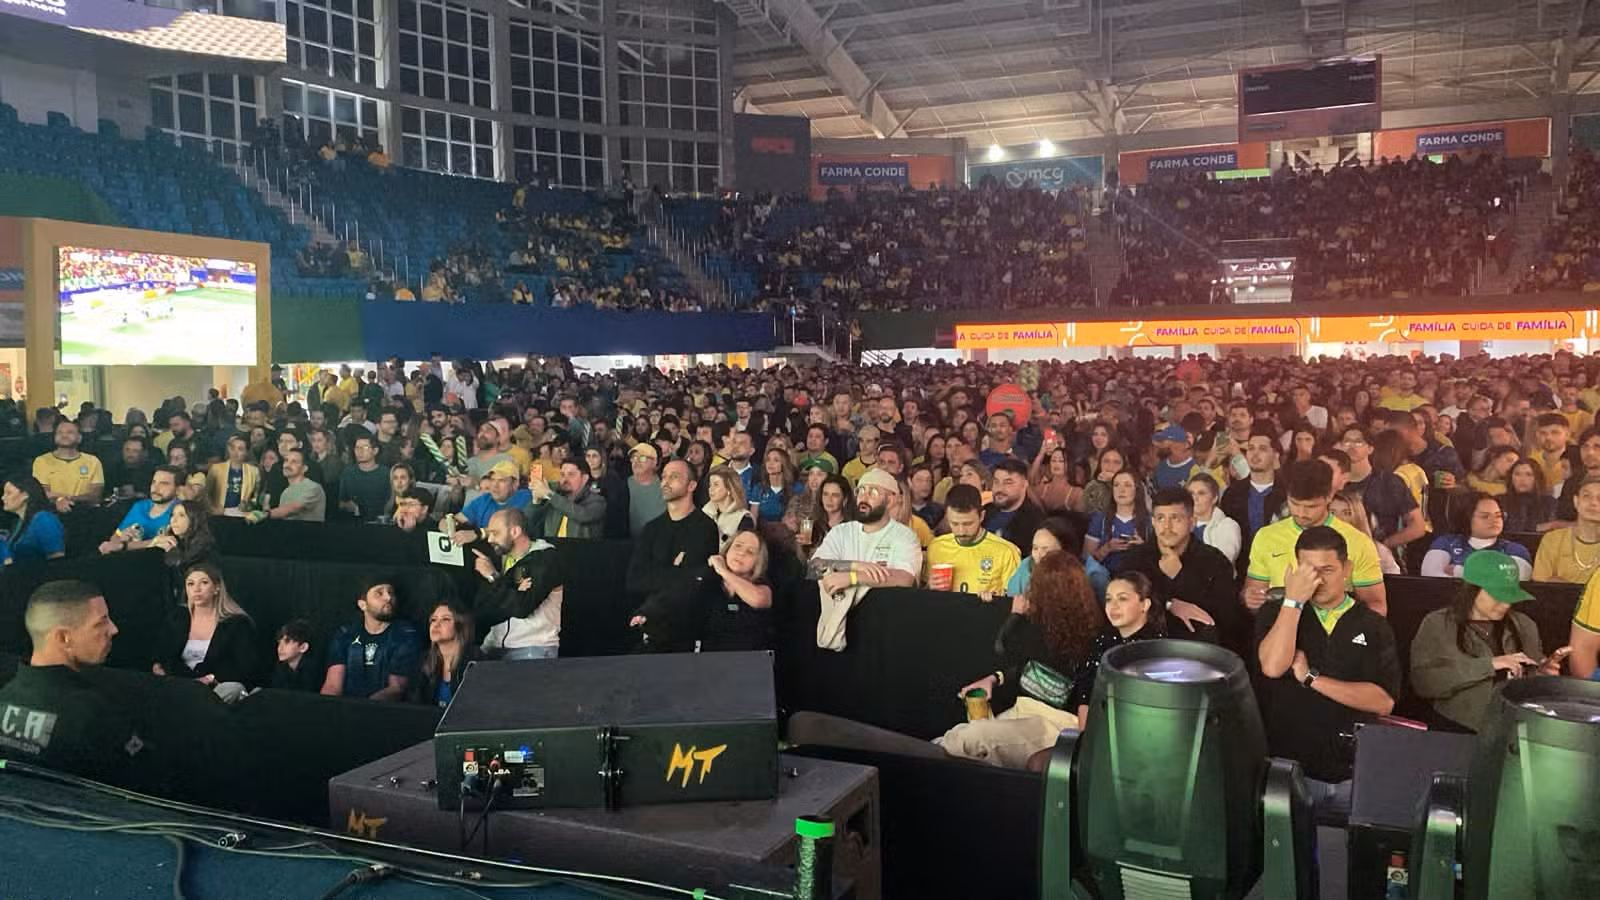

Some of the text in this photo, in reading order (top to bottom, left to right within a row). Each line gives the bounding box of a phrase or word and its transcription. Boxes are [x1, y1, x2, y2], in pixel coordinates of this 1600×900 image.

[1419, 131, 1503, 147] FARMA CONDE
[1150, 154, 1234, 170] FARMA CONDE
[821, 167, 906, 177] FARMA CONDE
[1028, 167, 1064, 185] mcg
[1156, 324, 1295, 337] FAMÍLIA CUIDA DE FAMÍLIA
[1408, 319, 1568, 332] FAMÍLIA CUIDA DE FAMÍLIA
[1012, 329, 1053, 341] FAMÍLIA
[666, 743, 728, 788] MT
[347, 808, 388, 839] MT
